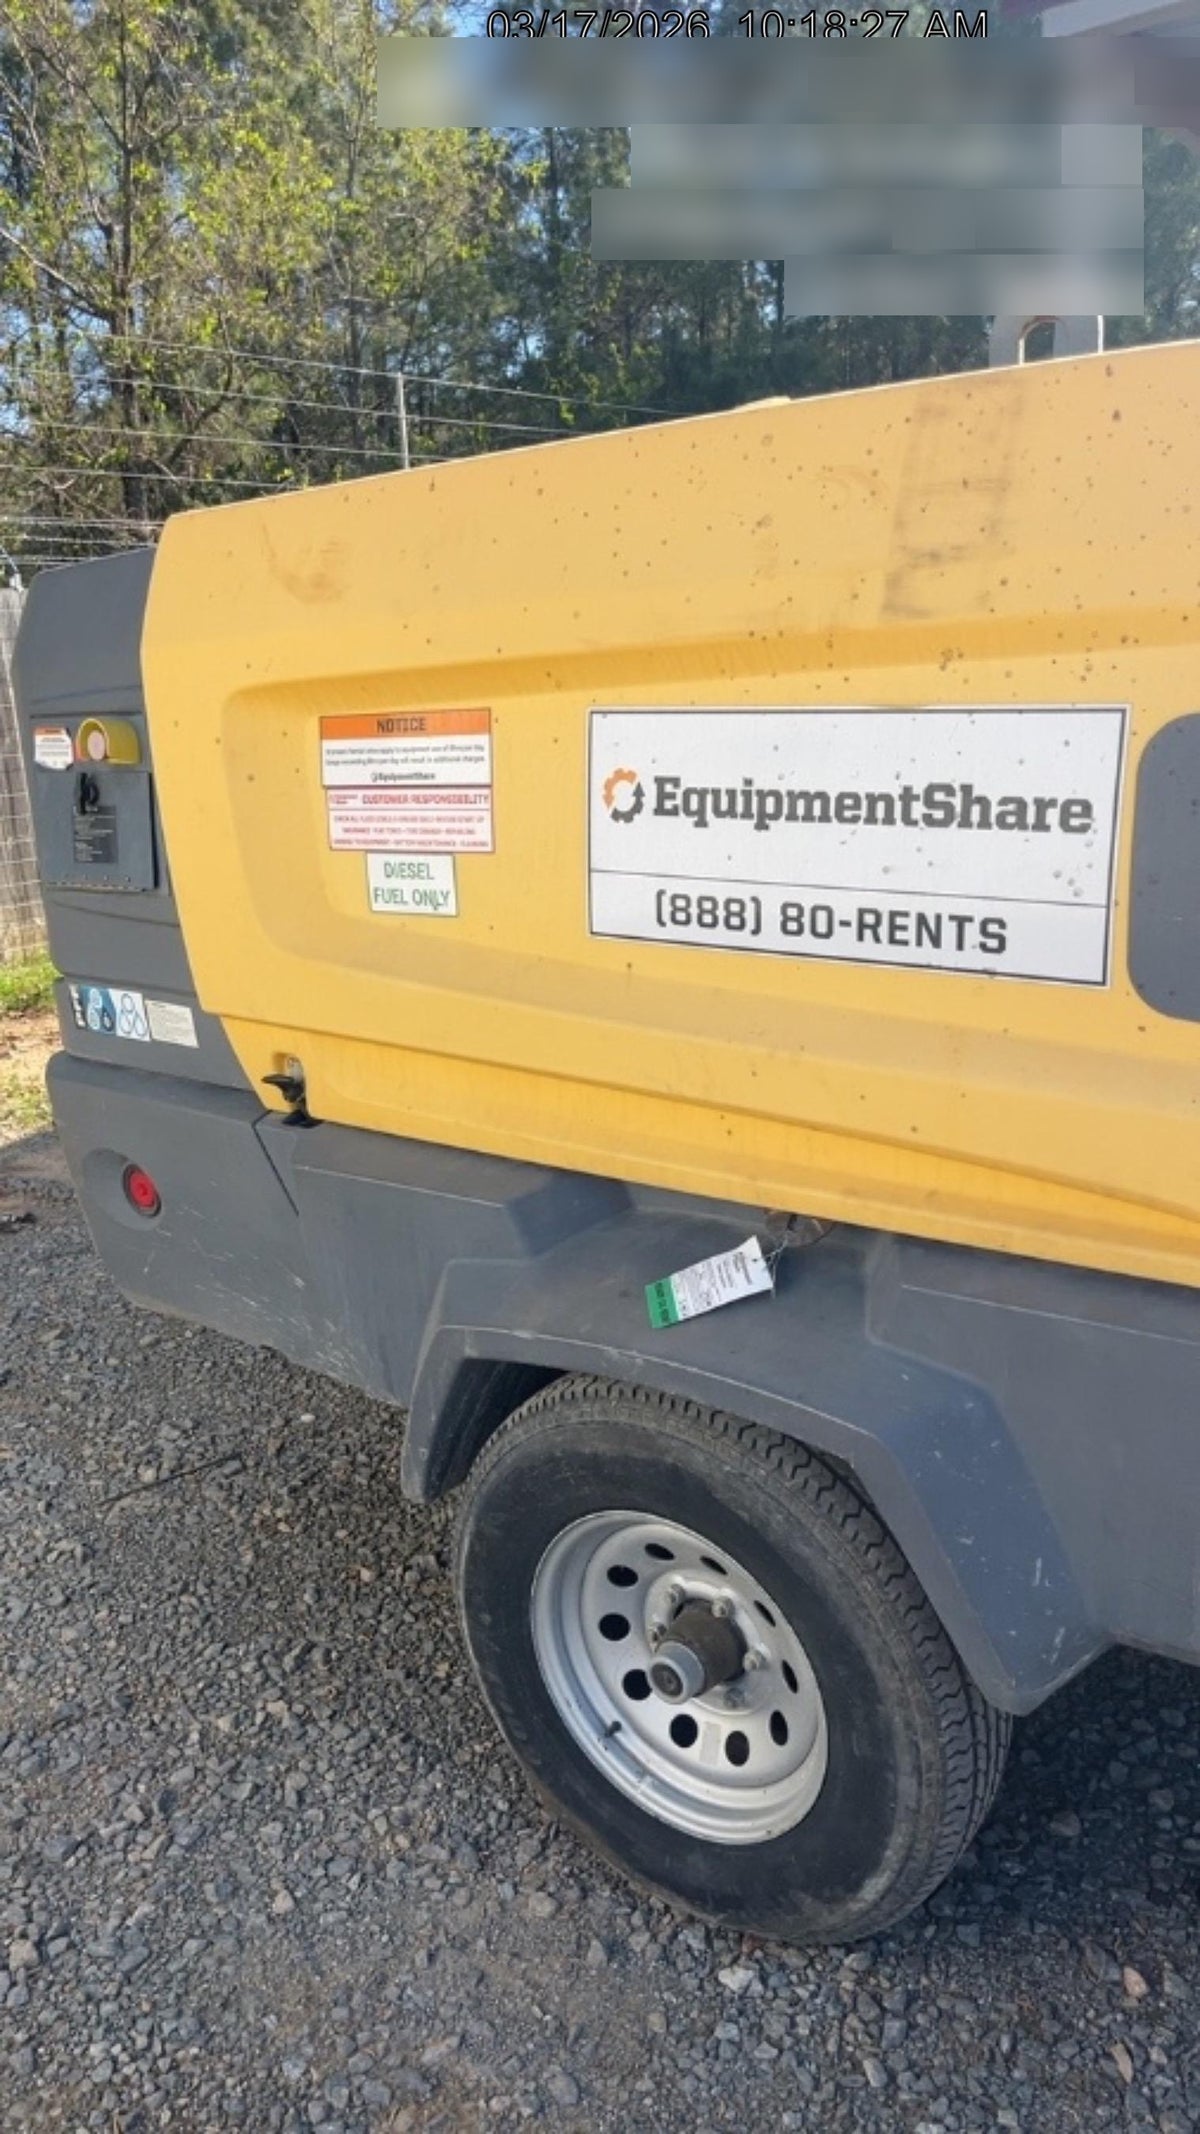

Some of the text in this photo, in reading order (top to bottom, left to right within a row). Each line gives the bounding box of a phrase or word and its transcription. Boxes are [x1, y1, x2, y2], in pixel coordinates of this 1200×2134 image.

[376, 717, 426, 734] NOTICE
[411, 793, 489, 805] RESPONSIBILITY
[652, 775, 1095, 834] EquipmentShare
[383, 861, 435, 880] DIESEL
[373, 887, 450, 907] FUEL ONLY
[655, 889, 1008, 955] (888) 80-RENTS
